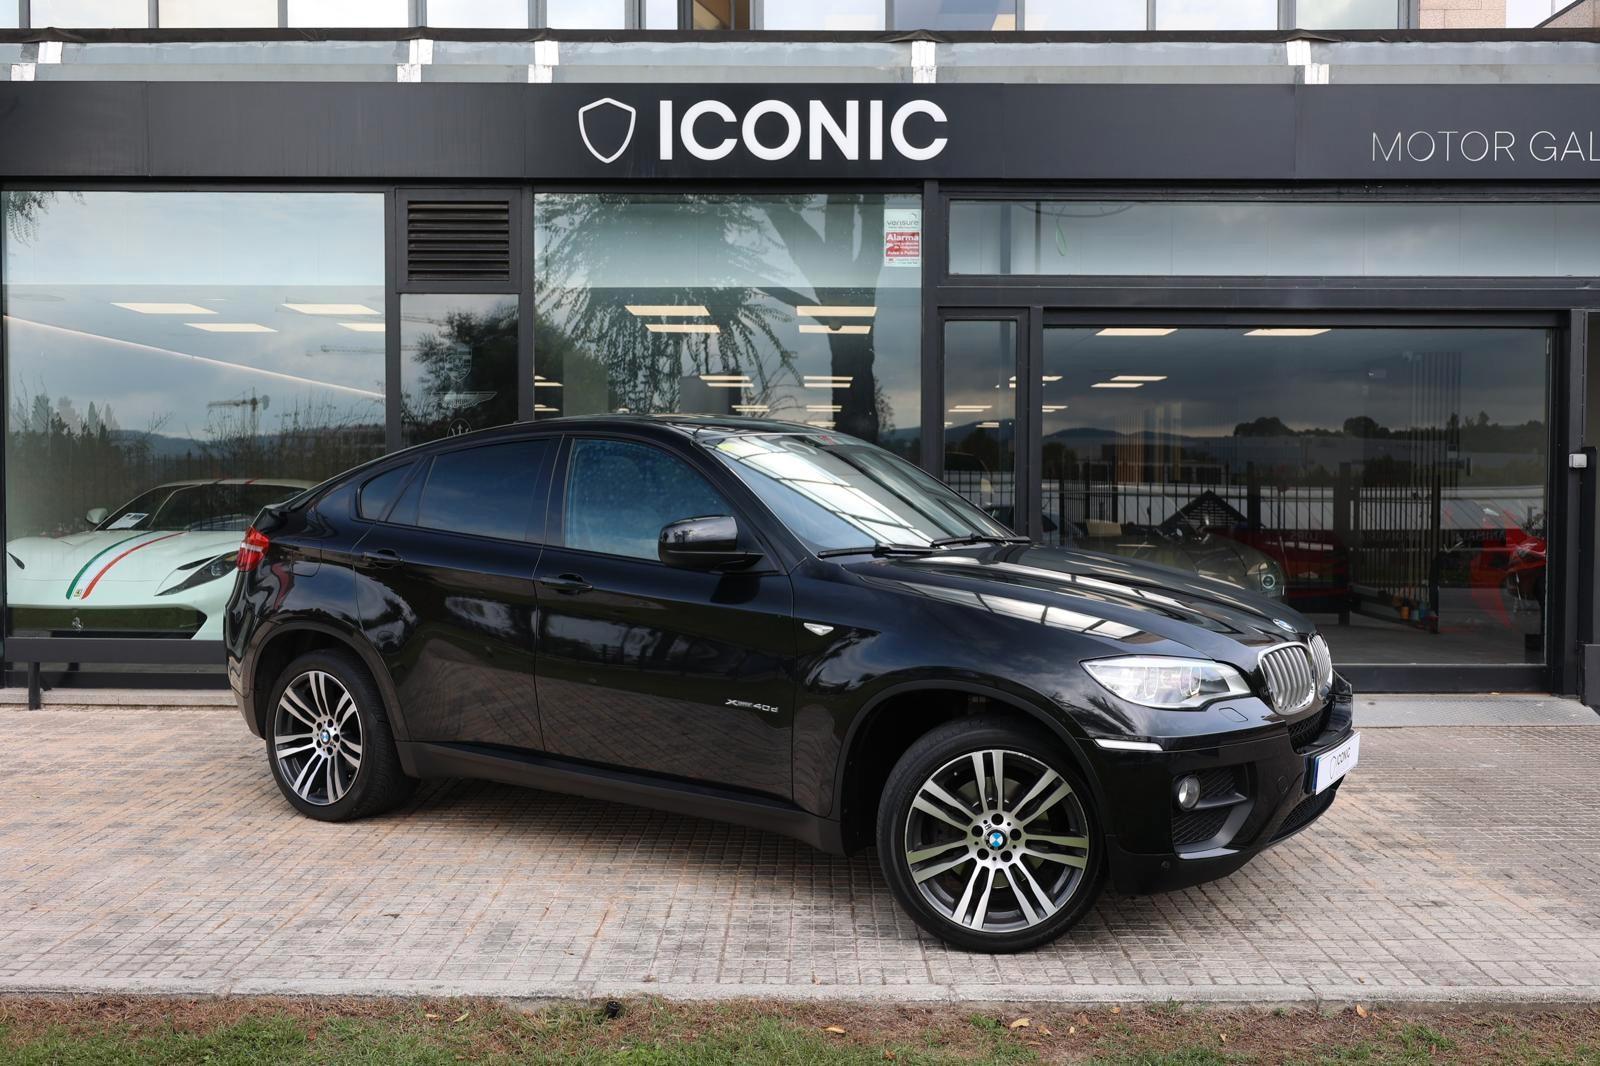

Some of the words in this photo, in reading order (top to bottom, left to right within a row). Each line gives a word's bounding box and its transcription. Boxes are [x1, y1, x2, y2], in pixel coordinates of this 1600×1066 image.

[659, 99, 948, 161] ICONIC
[1372, 130, 1516, 162] MOTOR
[1529, 130, 1600, 162] GAL
[886, 233, 919, 241] Alarma
